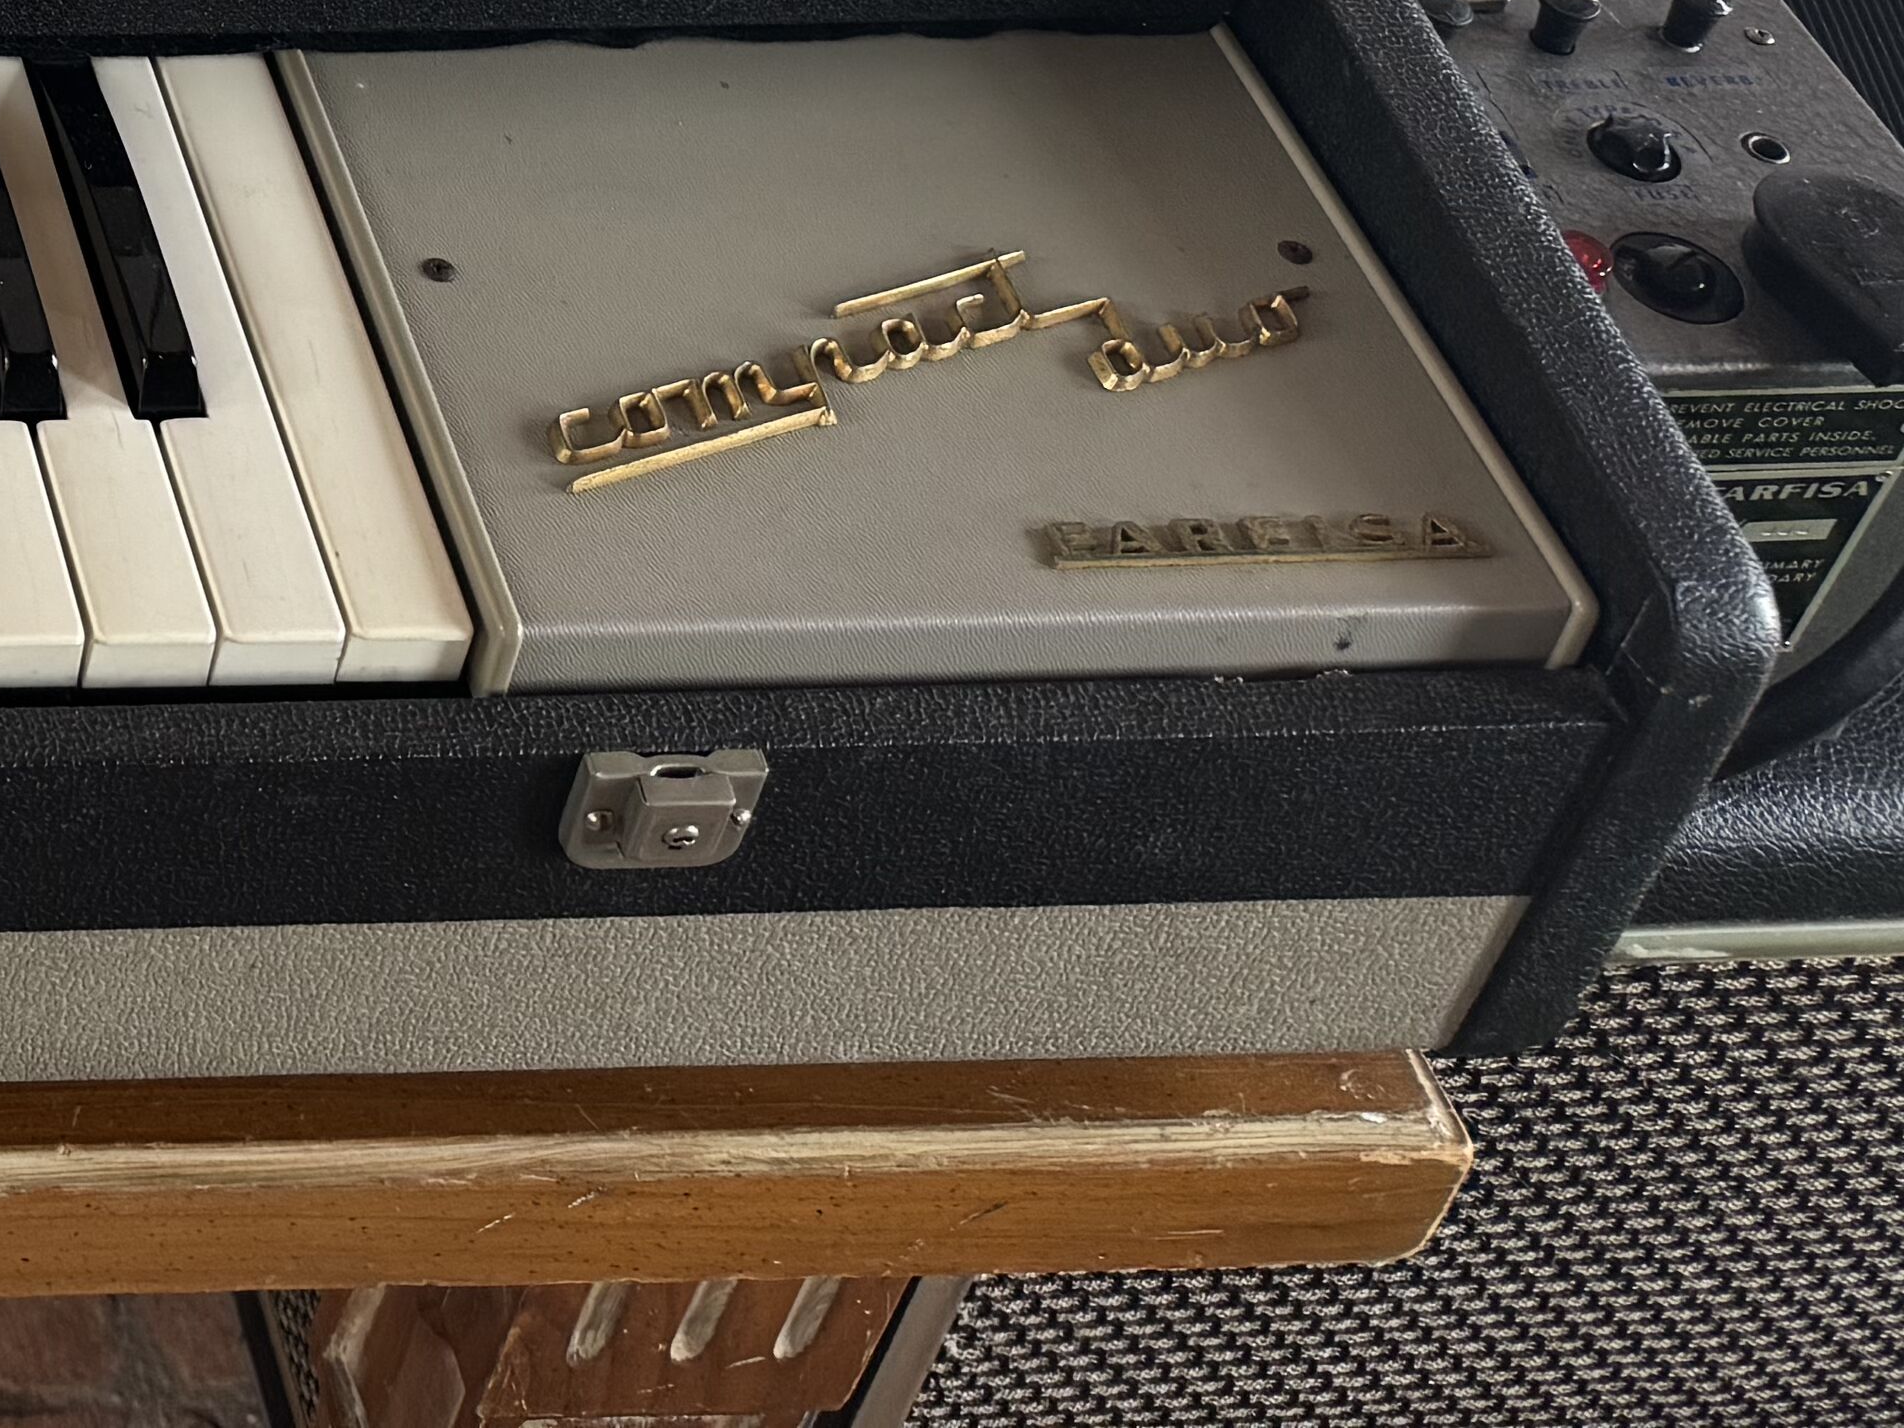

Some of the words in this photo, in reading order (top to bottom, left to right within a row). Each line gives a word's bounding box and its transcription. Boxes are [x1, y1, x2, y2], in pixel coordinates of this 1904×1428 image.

[1744, 400, 1846, 413] ELECTRICAL
[1758, 416, 1825, 429] COVER
[1742, 431, 1799, 443] PARTS
[1809, 429, 1876, 442] INSIDE.
[1726, 447, 1792, 459] SERVICE
[1045, 512, 1479, 556] FARFISA
